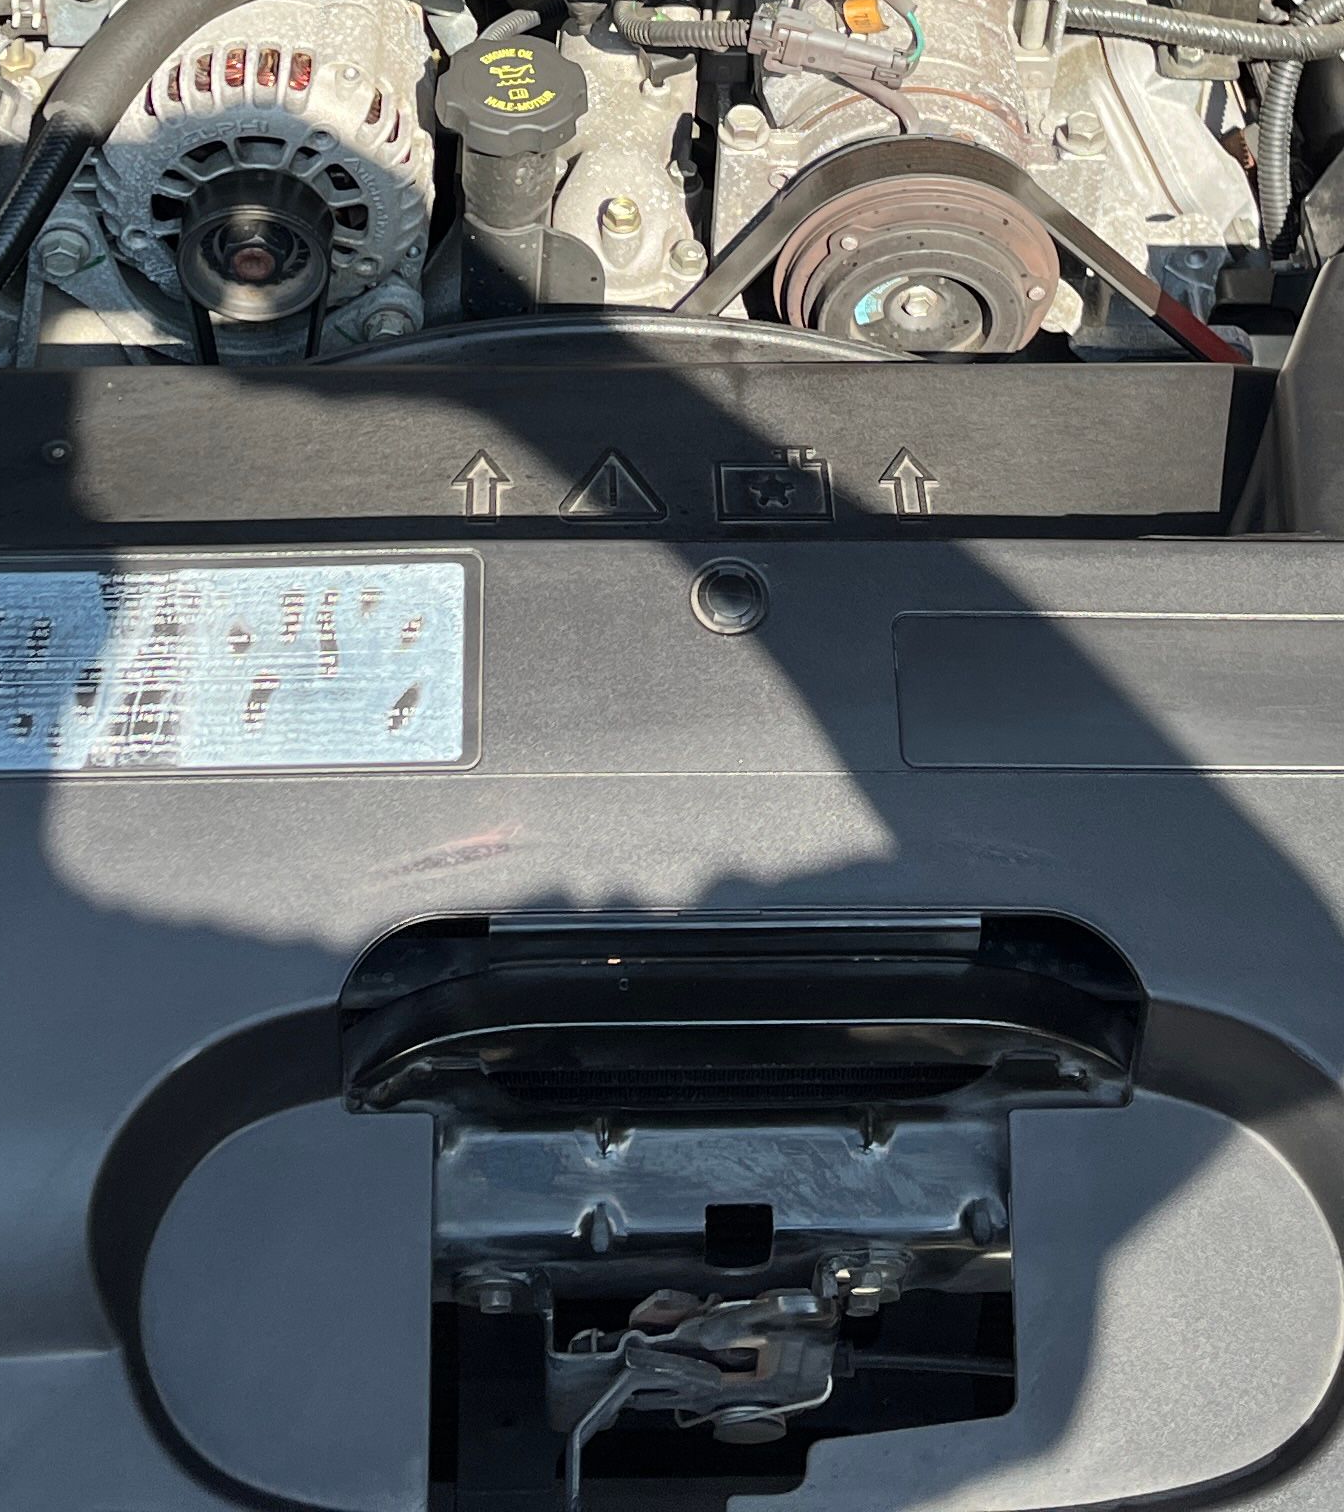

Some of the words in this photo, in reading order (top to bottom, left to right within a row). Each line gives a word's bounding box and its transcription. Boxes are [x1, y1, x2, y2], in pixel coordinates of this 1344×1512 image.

[479, 48, 516, 65] ENGINE
[517, 48, 534, 61] OIL
[484, 90, 556, 112] HUILE-MOTEUR
